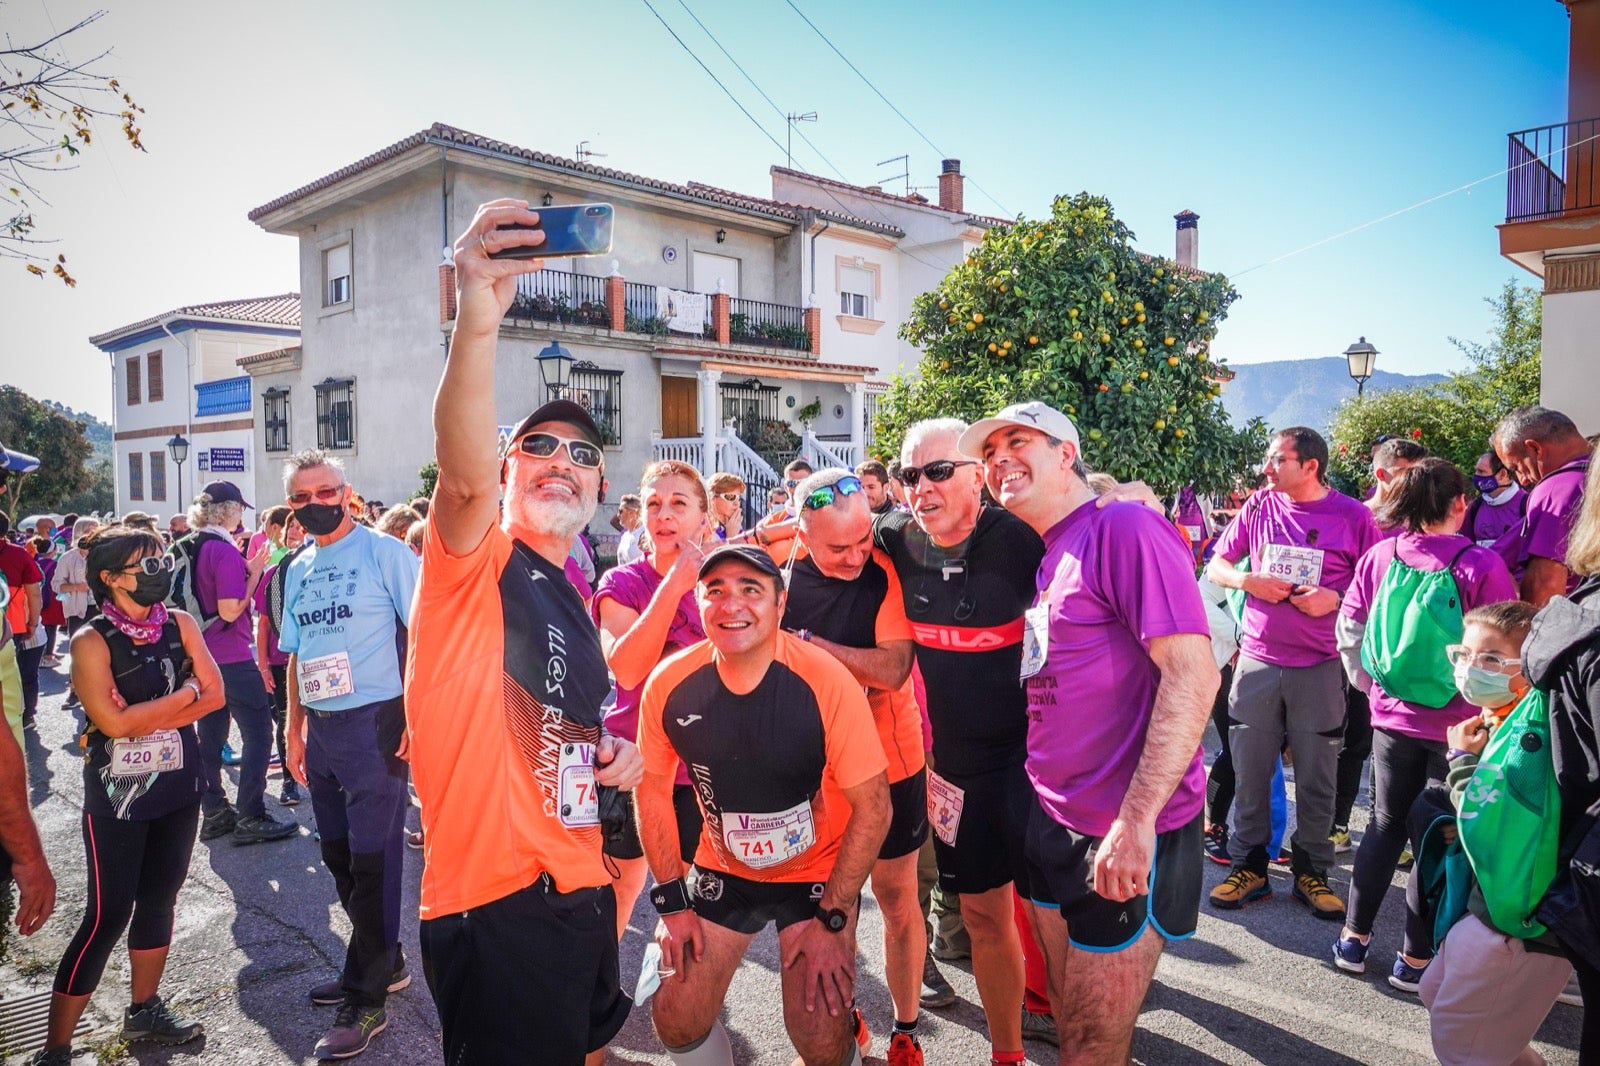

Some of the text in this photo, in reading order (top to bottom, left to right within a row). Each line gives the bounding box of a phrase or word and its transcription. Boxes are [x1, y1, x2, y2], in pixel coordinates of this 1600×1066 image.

[1269, 563, 1292, 575] 635
[298, 600, 353, 627] nerja
[307, 625, 345, 639] ATTISMO
[913, 625, 1005, 648] FILA
[304, 679, 321, 694] 609
[121, 751, 152, 764] 420
[579, 744, 590, 764] V
[738, 814, 786, 830] V CARRERA
[739, 839, 774, 857] 741
